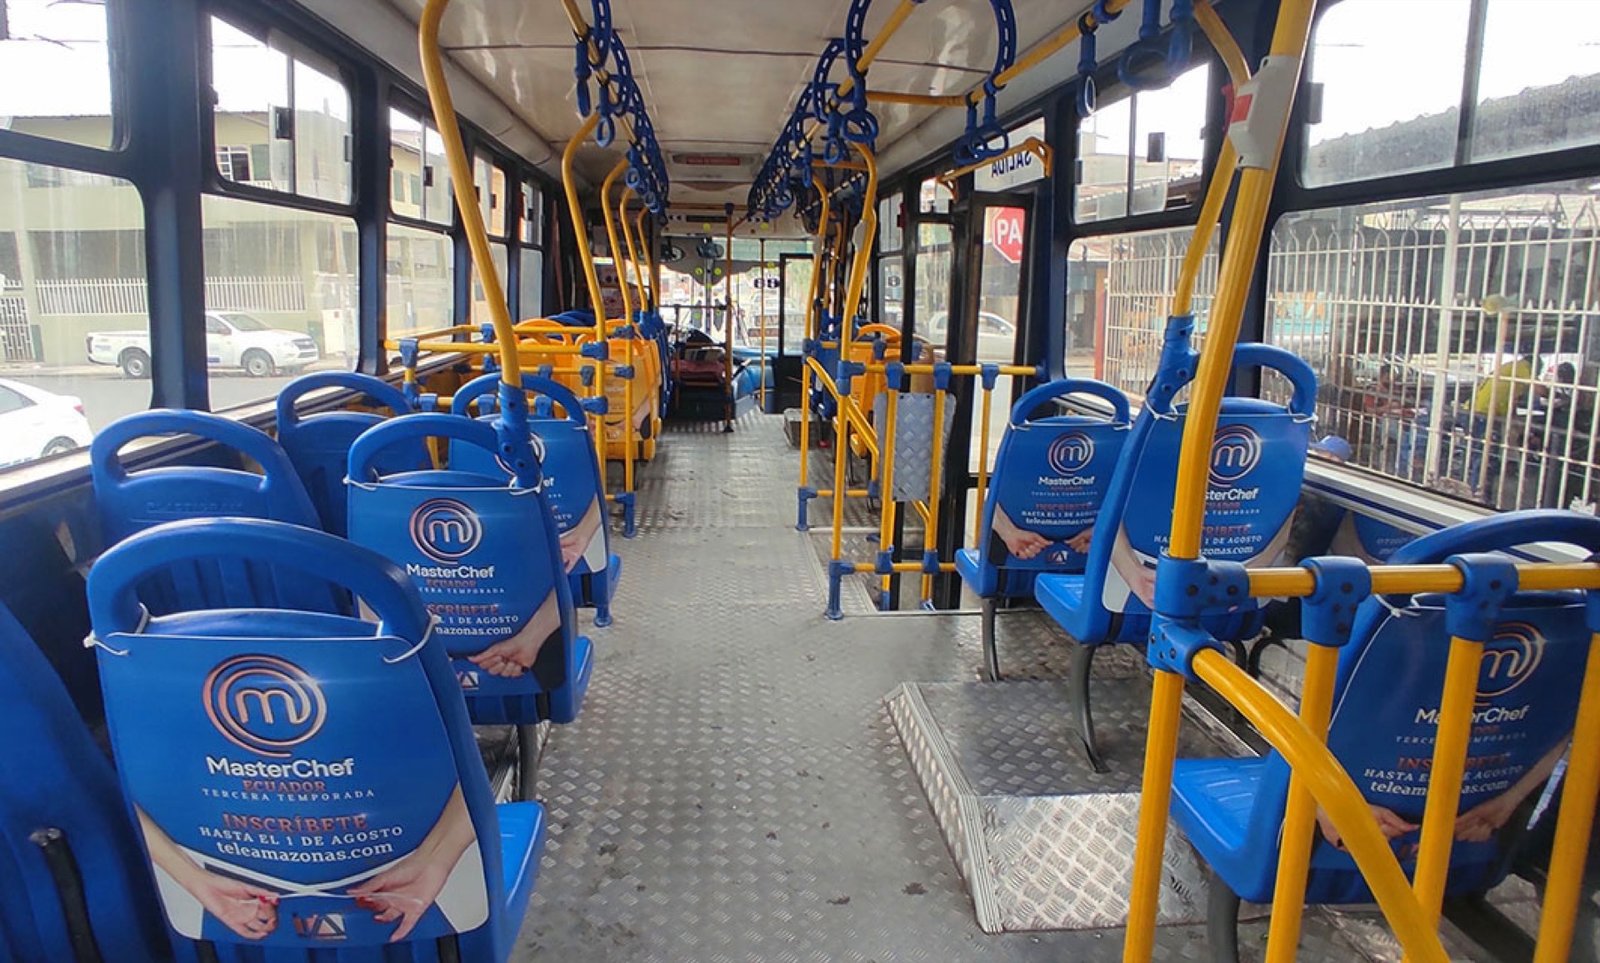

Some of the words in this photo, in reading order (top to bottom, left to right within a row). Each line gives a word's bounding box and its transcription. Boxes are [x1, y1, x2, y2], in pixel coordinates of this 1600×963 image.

[997, 218, 1023, 245] PA
[1204, 488, 1259, 501] sterChef
[406, 563, 495, 578] MasterChef
[458, 616, 472, 624] DE
[475, 615, 519, 625] AGOSTO
[205, 756, 355, 778] MasterChef
[1364, 768, 1413, 782] HASTA
[242, 780, 327, 794] ECUADOR
[202, 788, 271, 801] TERCERA
[277, 789, 375, 802] TEMPORADA
[222, 812, 369, 833] INSCRÍBETE
[199, 826, 254, 843] HASTA
[258, 834, 280, 846] EL
[285, 835, 293, 846] 1
[301, 835, 325, 847] DE
[330, 825, 404, 846] AGOSTO
[216, 840, 394, 864] teleamazonas.com
